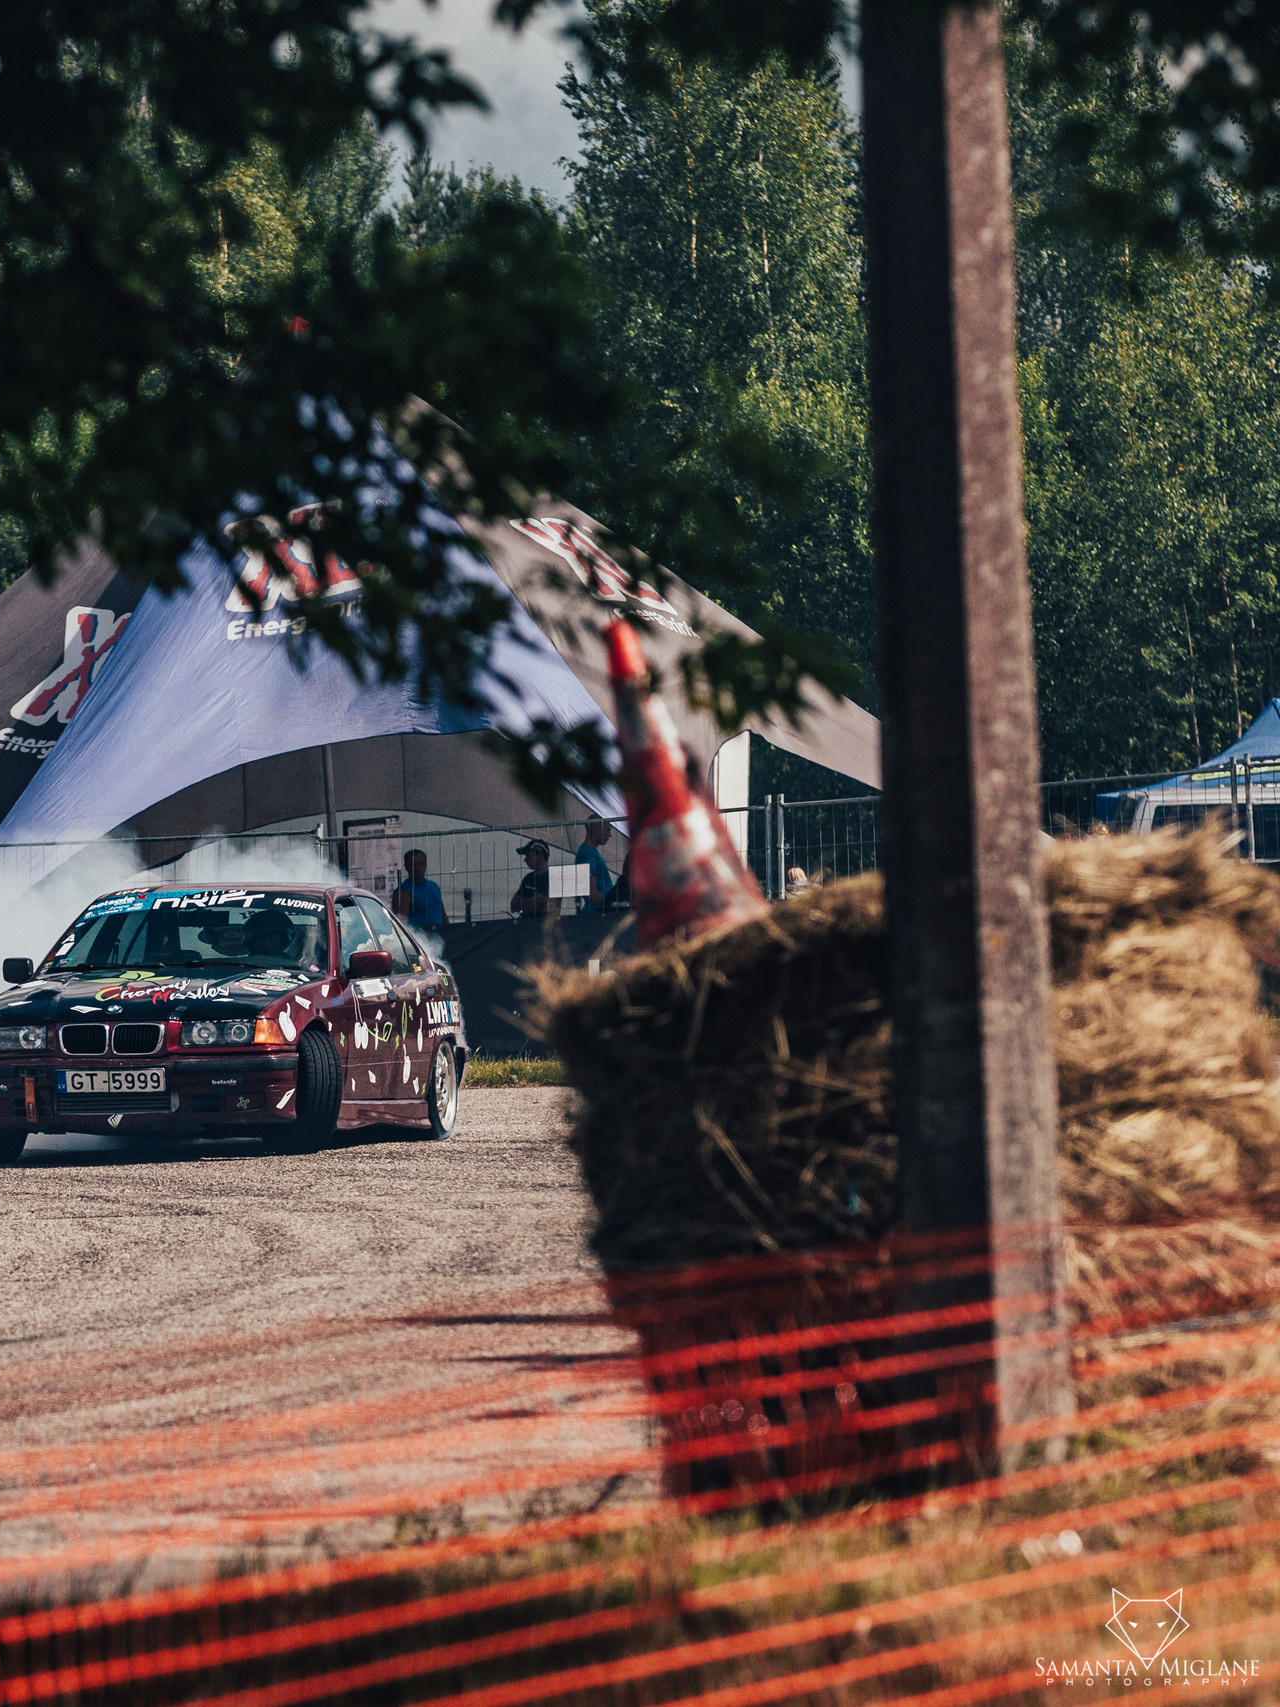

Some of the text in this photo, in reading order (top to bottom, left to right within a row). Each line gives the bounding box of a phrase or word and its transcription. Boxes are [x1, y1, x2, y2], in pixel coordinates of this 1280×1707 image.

[227, 616, 308, 641] Energ
[152, 892, 266, 910] DRIFT
[273, 897, 325, 913] #LVDRIFT
[71, 1073, 161, 1090] GT-5999
